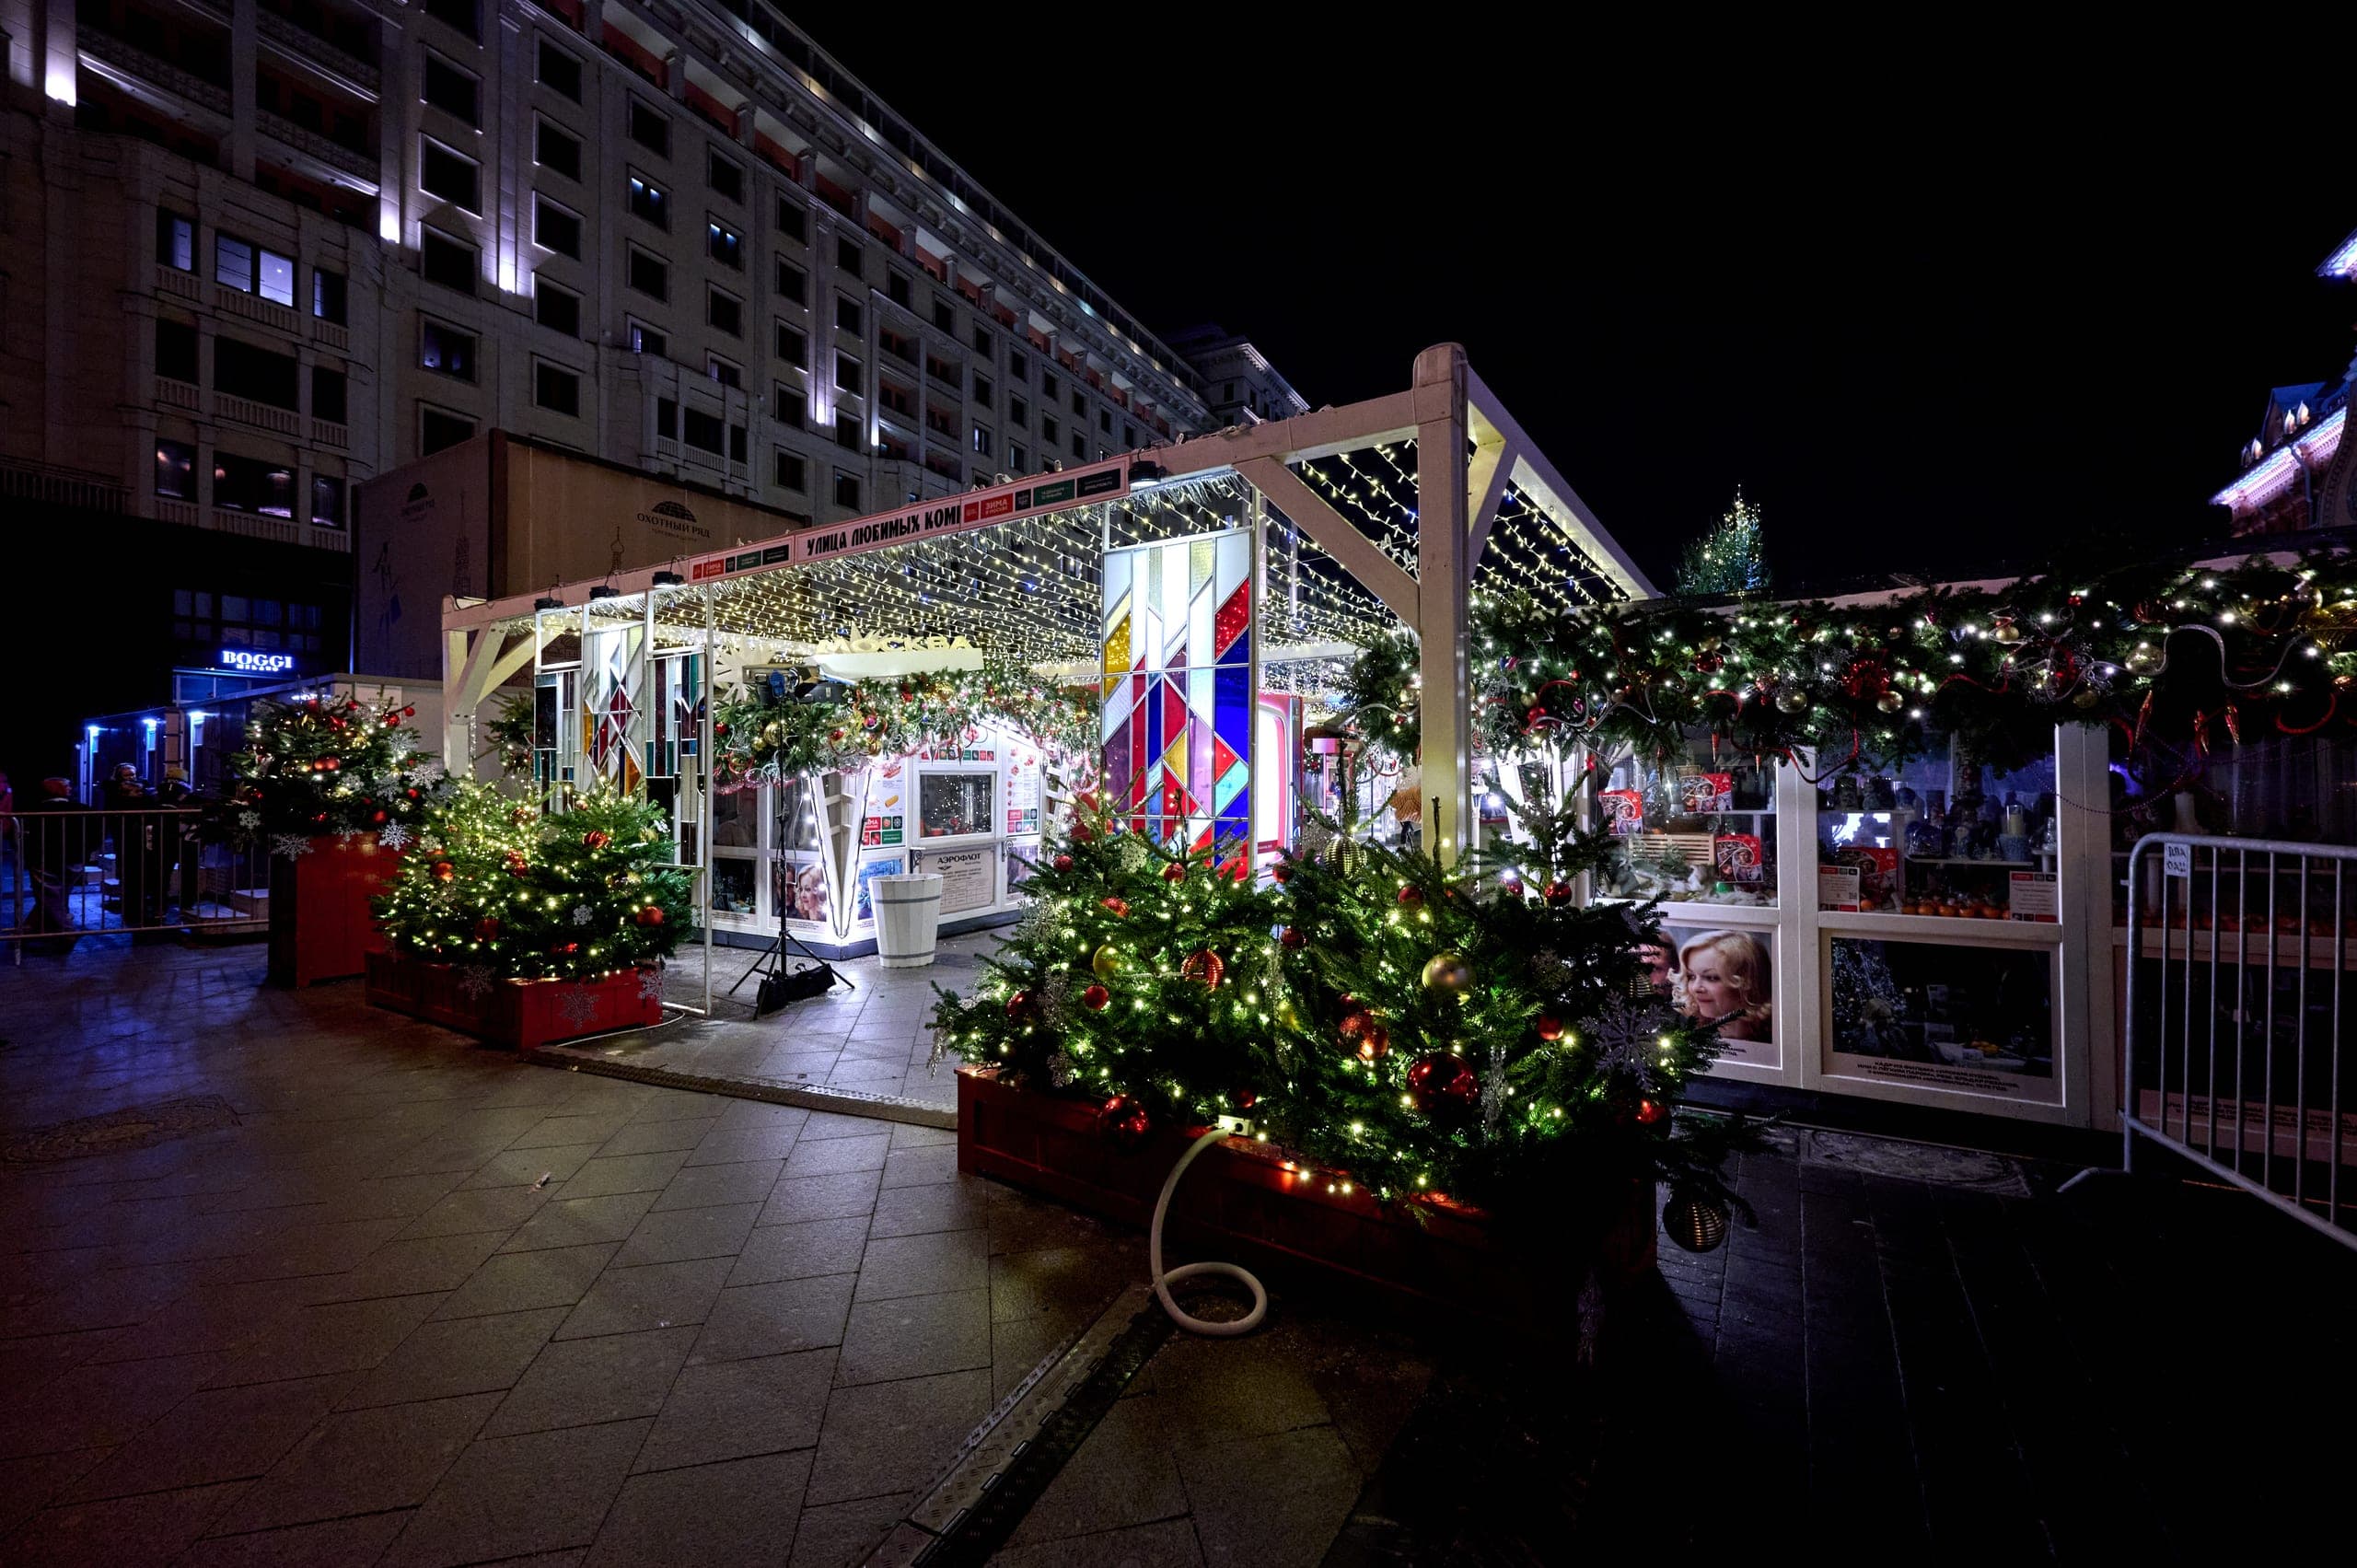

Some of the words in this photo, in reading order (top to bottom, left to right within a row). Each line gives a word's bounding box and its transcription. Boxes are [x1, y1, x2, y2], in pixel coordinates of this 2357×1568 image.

[637, 513, 689, 532] ОХОТНЫЙ
[692, 526, 710, 539] РЯД
[807, 531, 847, 555] УЛИЦА
[852, 514, 920, 547] ЛЮБИМЫХ
[223, 650, 292, 668] BOGGI
[937, 853, 981, 864] АЭРОФЛОТ
